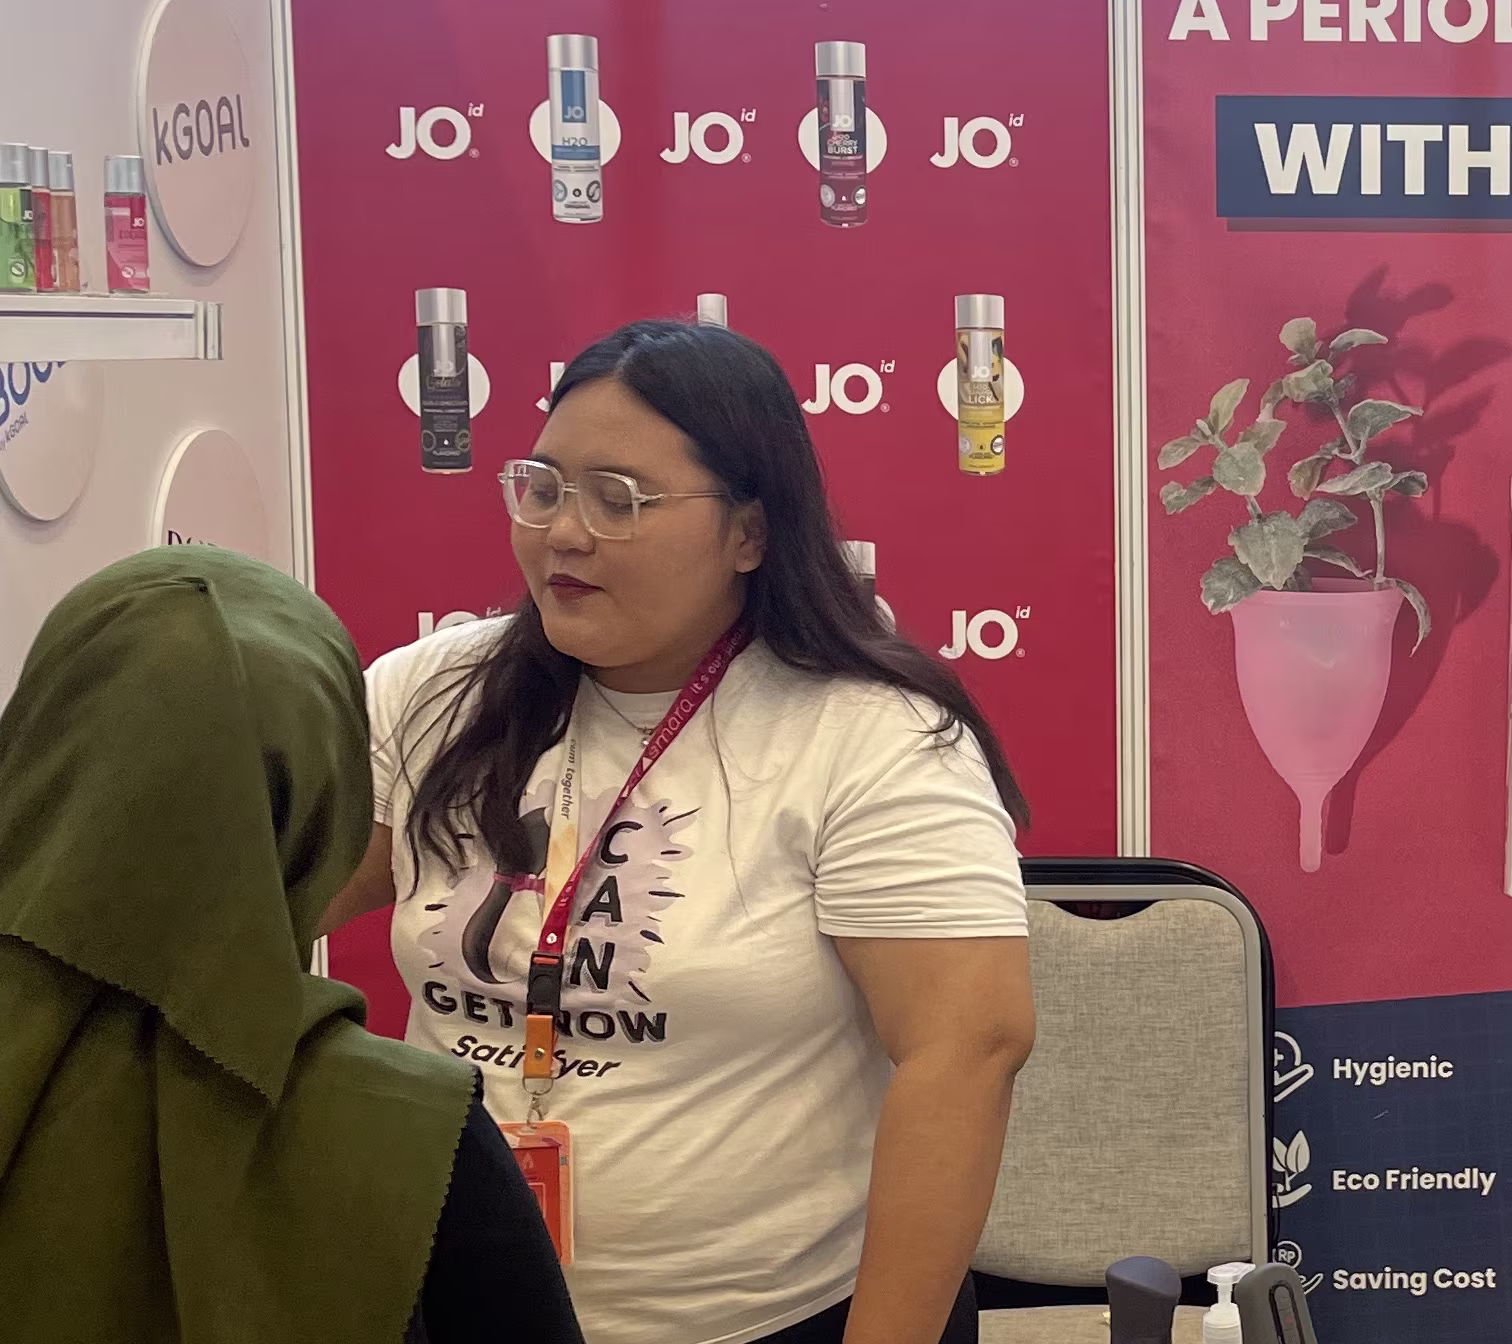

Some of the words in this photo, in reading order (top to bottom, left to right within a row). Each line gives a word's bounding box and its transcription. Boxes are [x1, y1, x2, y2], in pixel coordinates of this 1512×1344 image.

[564, 105, 585, 120] JO
[832, 114, 853, 128] JO
[386, 107, 471, 159] JO
[561, 136, 588, 146] H2O
[660, 112, 743, 164] JO
[930, 117, 1011, 168] JO
[827, 145, 858, 154] BURST
[1253, 123, 1511, 196] WITH
[971, 365, 991, 379] JO
[802, 364, 882, 414] JO
[968, 395, 994, 404] LICK
[939, 610, 1018, 659] JO
[560, 766, 577, 820] together
[421, 981, 515, 1029] GET
[1333, 1055, 1454, 1086] Hygienic
[1332, 1170, 1380, 1191] Eco
[1386, 1167, 1497, 1196] Friendly
[1333, 1268, 1428, 1296] Saving
[1433, 1268, 1497, 1289] Cost
